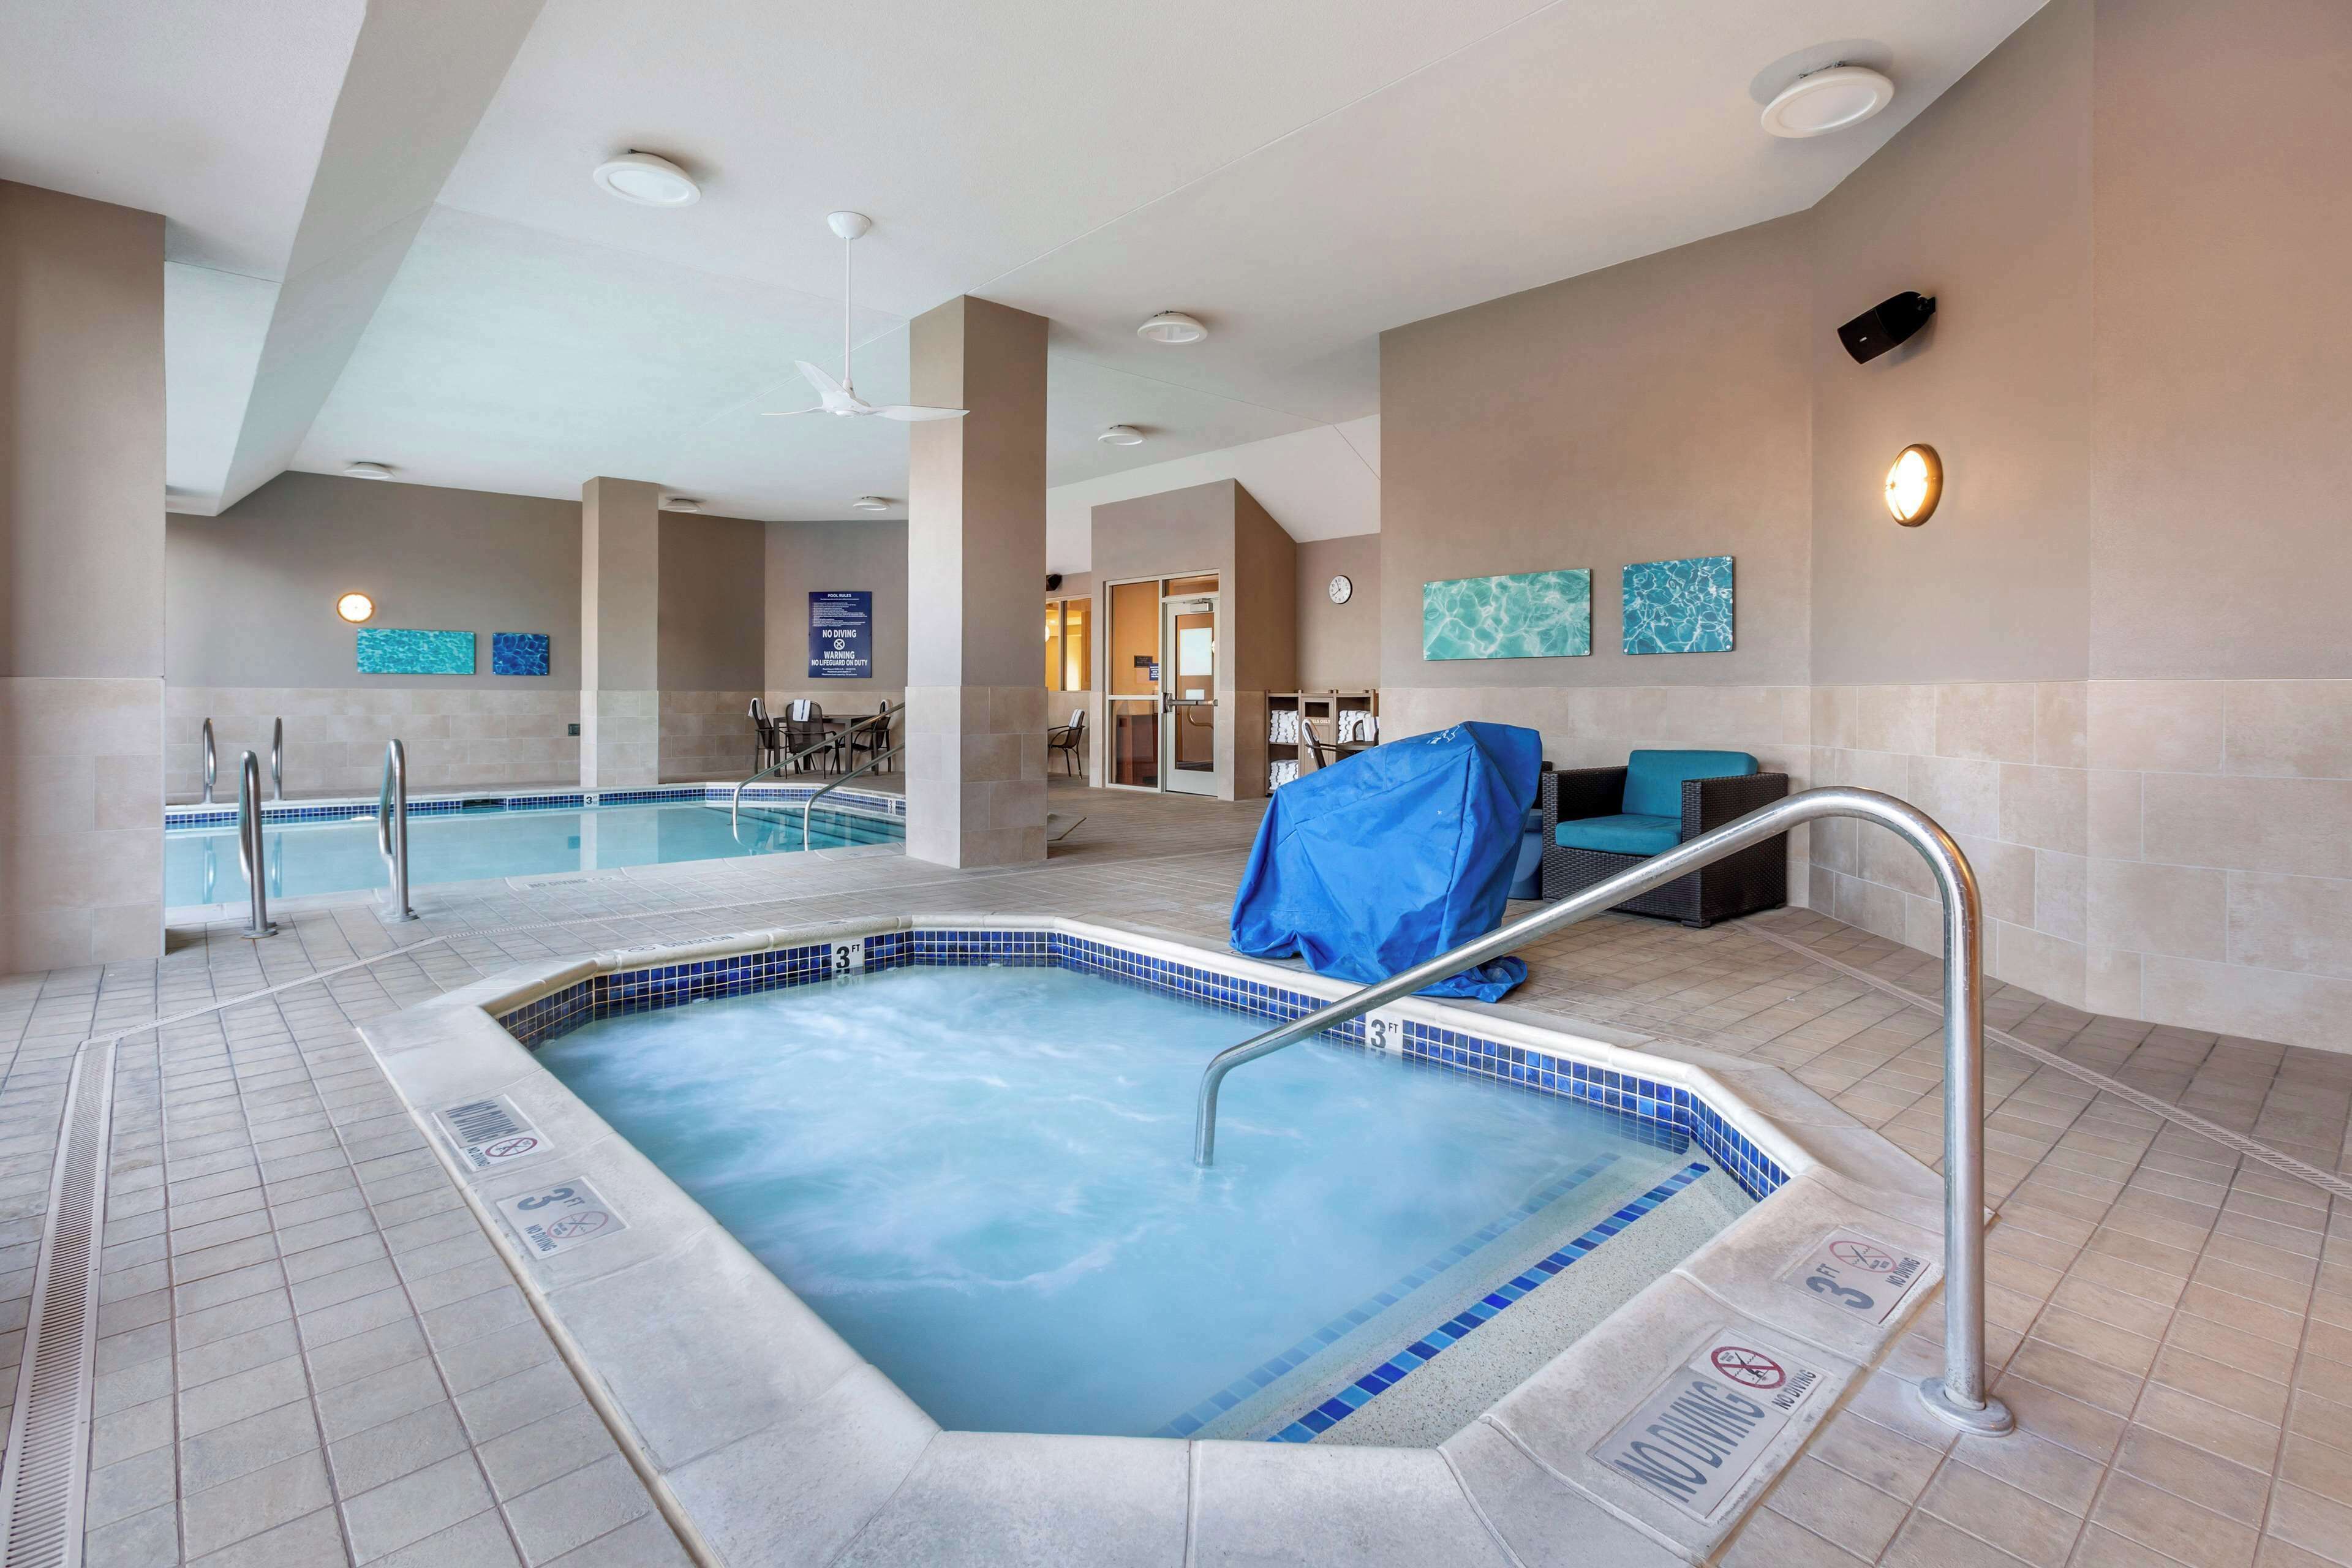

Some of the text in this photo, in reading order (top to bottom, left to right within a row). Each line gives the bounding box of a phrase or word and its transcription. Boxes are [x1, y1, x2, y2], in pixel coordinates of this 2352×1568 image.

[661, 934, 735, 948] NO DIVING
[836, 944, 861, 968] 3 FT
[1371, 1019, 1399, 1048] 3 FT
[445, 1099, 519, 1142] NO DIVING
[470, 1152, 491, 1167] DIVING
[518, 1188, 586, 1210] 3 FT
[524, 1224, 558, 1251] NO DIVING
[1806, 1263, 1874, 1309] 3 FT
[1885, 1257, 1921, 1287] NO DIVING
[1771, 1370, 1817, 1410] NO DIVING
[1614, 1381, 1765, 1503] NO DIVING
